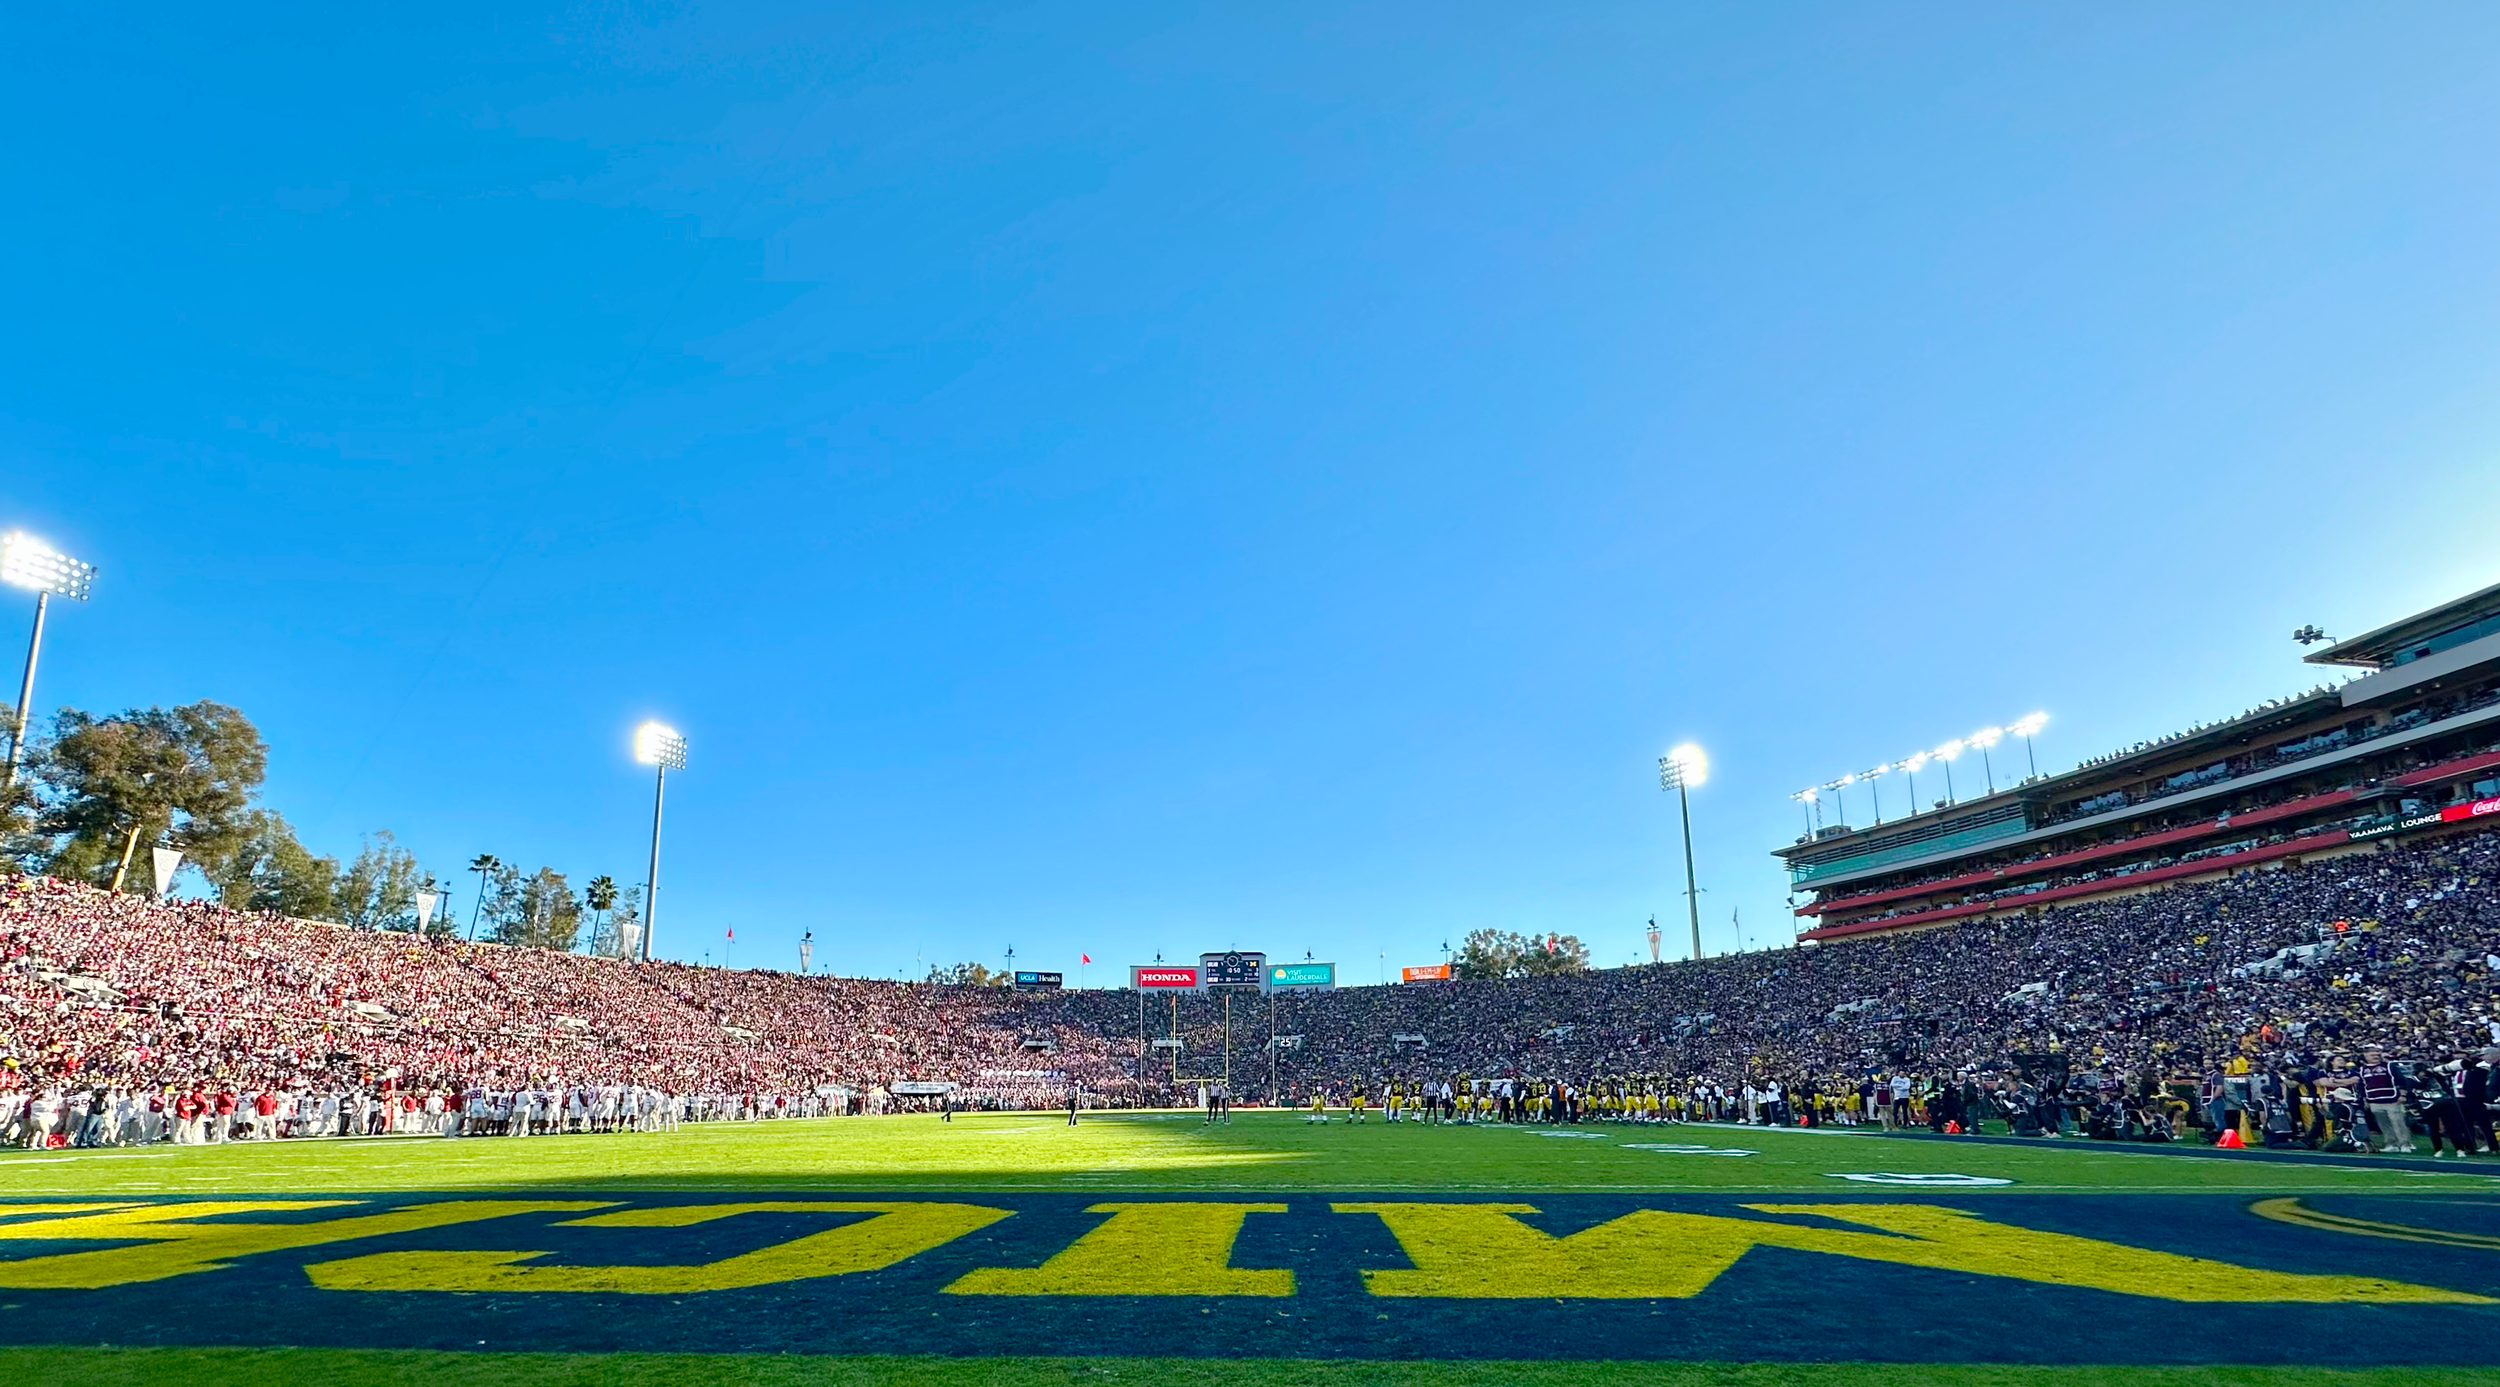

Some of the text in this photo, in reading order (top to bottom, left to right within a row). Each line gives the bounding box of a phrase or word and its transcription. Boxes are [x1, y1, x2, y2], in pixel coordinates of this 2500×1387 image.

[2401, 812, 2442, 829] LOUNGE
[1039, 974, 1060, 983] Health
[1141, 973, 1191, 981] HONDA
[1287, 973, 1328, 981] LAUDERDALE
[1280, 1038, 1291, 1046] 25
[0, 1200, 2500, 1304] MICH
